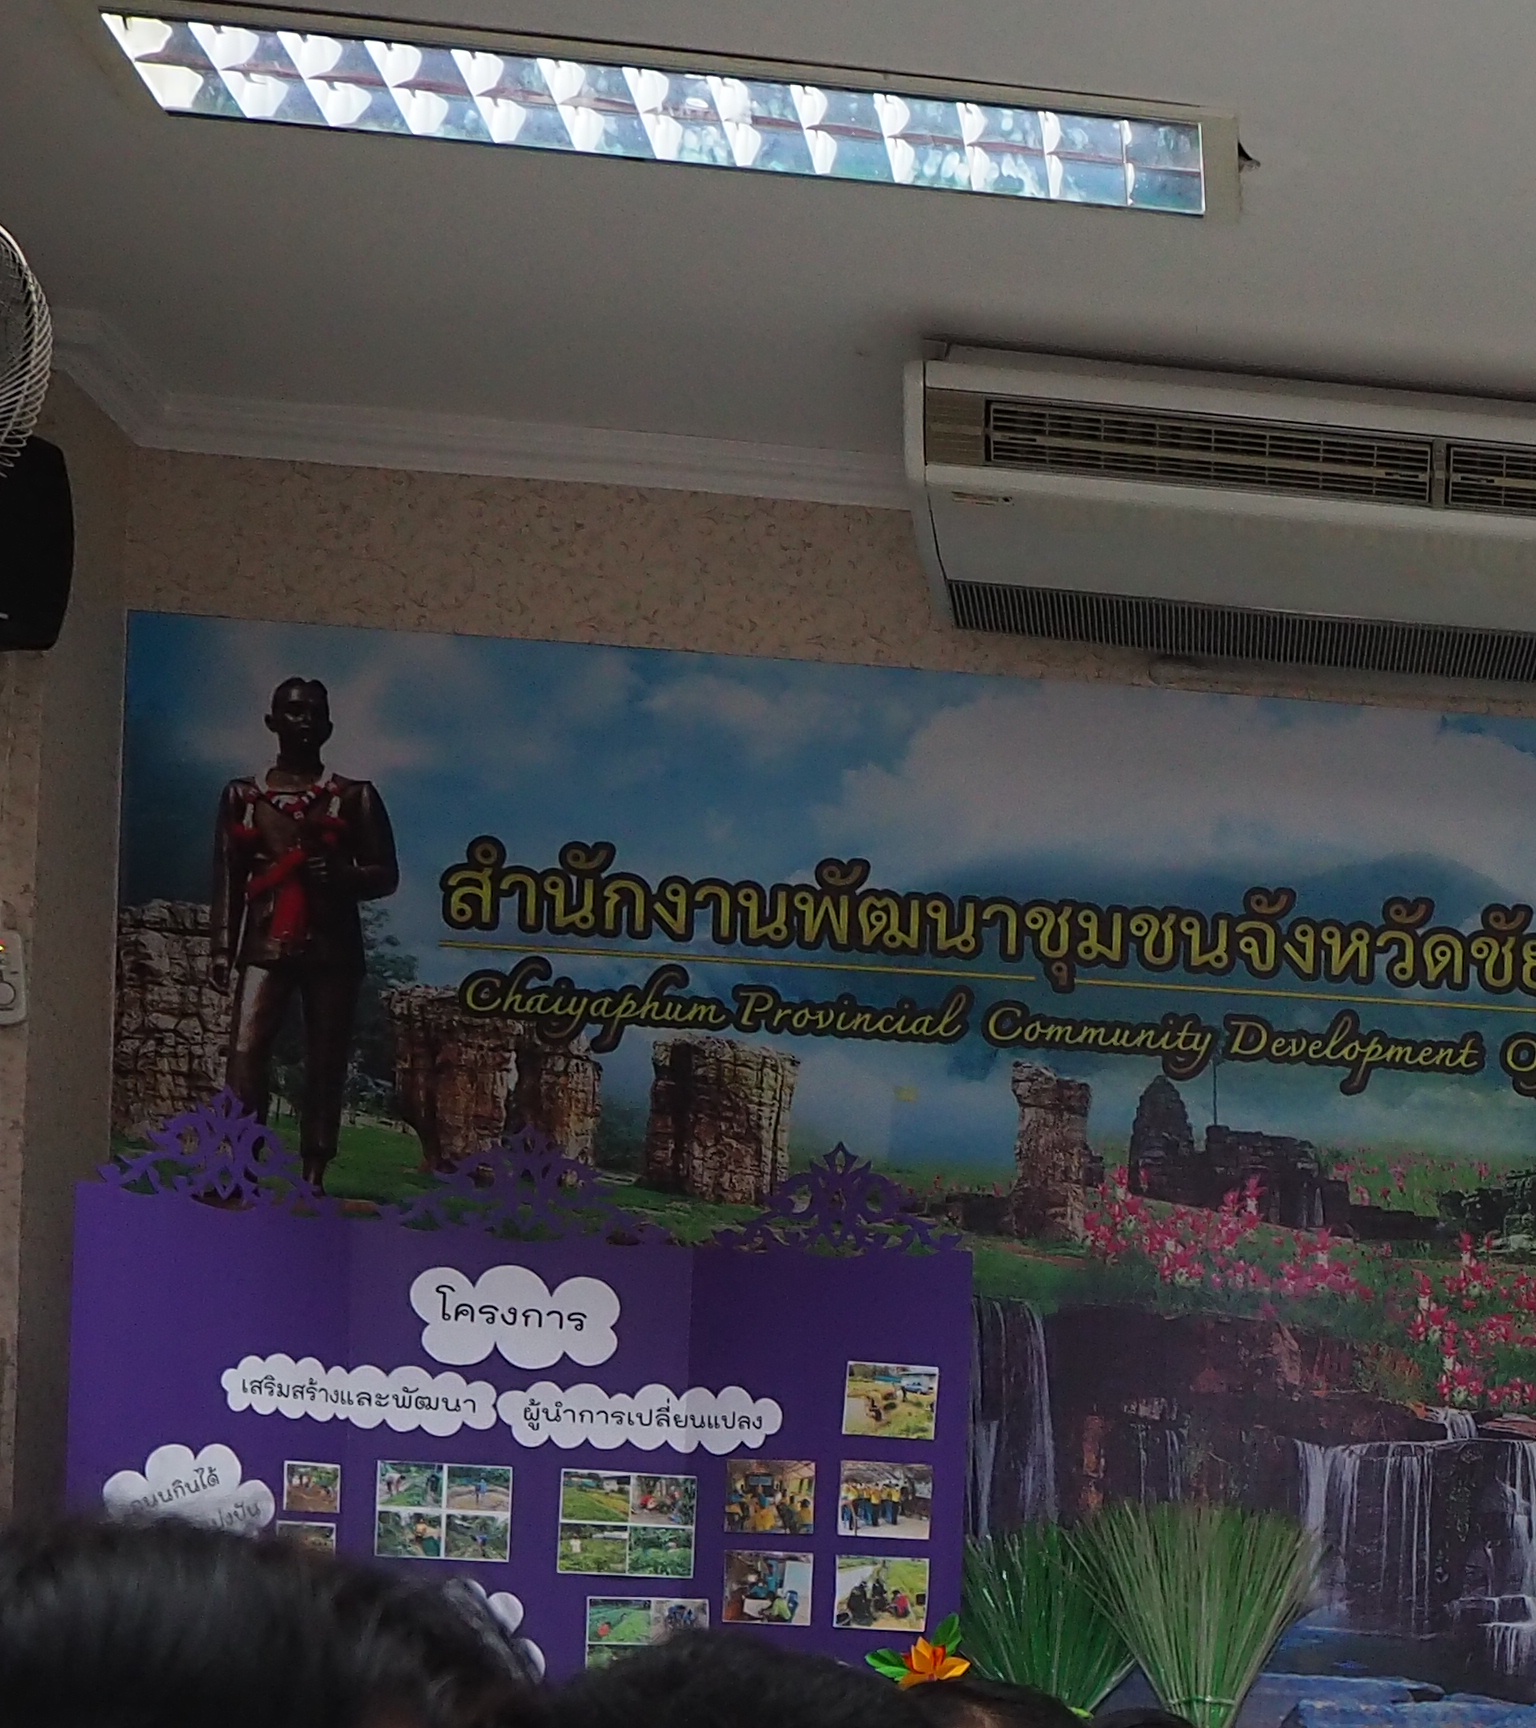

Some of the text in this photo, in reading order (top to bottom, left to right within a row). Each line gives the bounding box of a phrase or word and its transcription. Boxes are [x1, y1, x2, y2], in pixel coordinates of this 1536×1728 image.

[462, 960, 729, 1049] Chaiyaphum
[738, 990, 966, 1044] Provincial
[985, 1008, 1214, 1073] Community
[1228, 1013, 1481, 1093] Development
[435, 1284, 588, 1332] โครงการ
[241, 1374, 477, 1414] เสริมสร้างและพัฒนา
[523, 1398, 764, 1431] ผู้นำการเปลี่ยนแปลง
